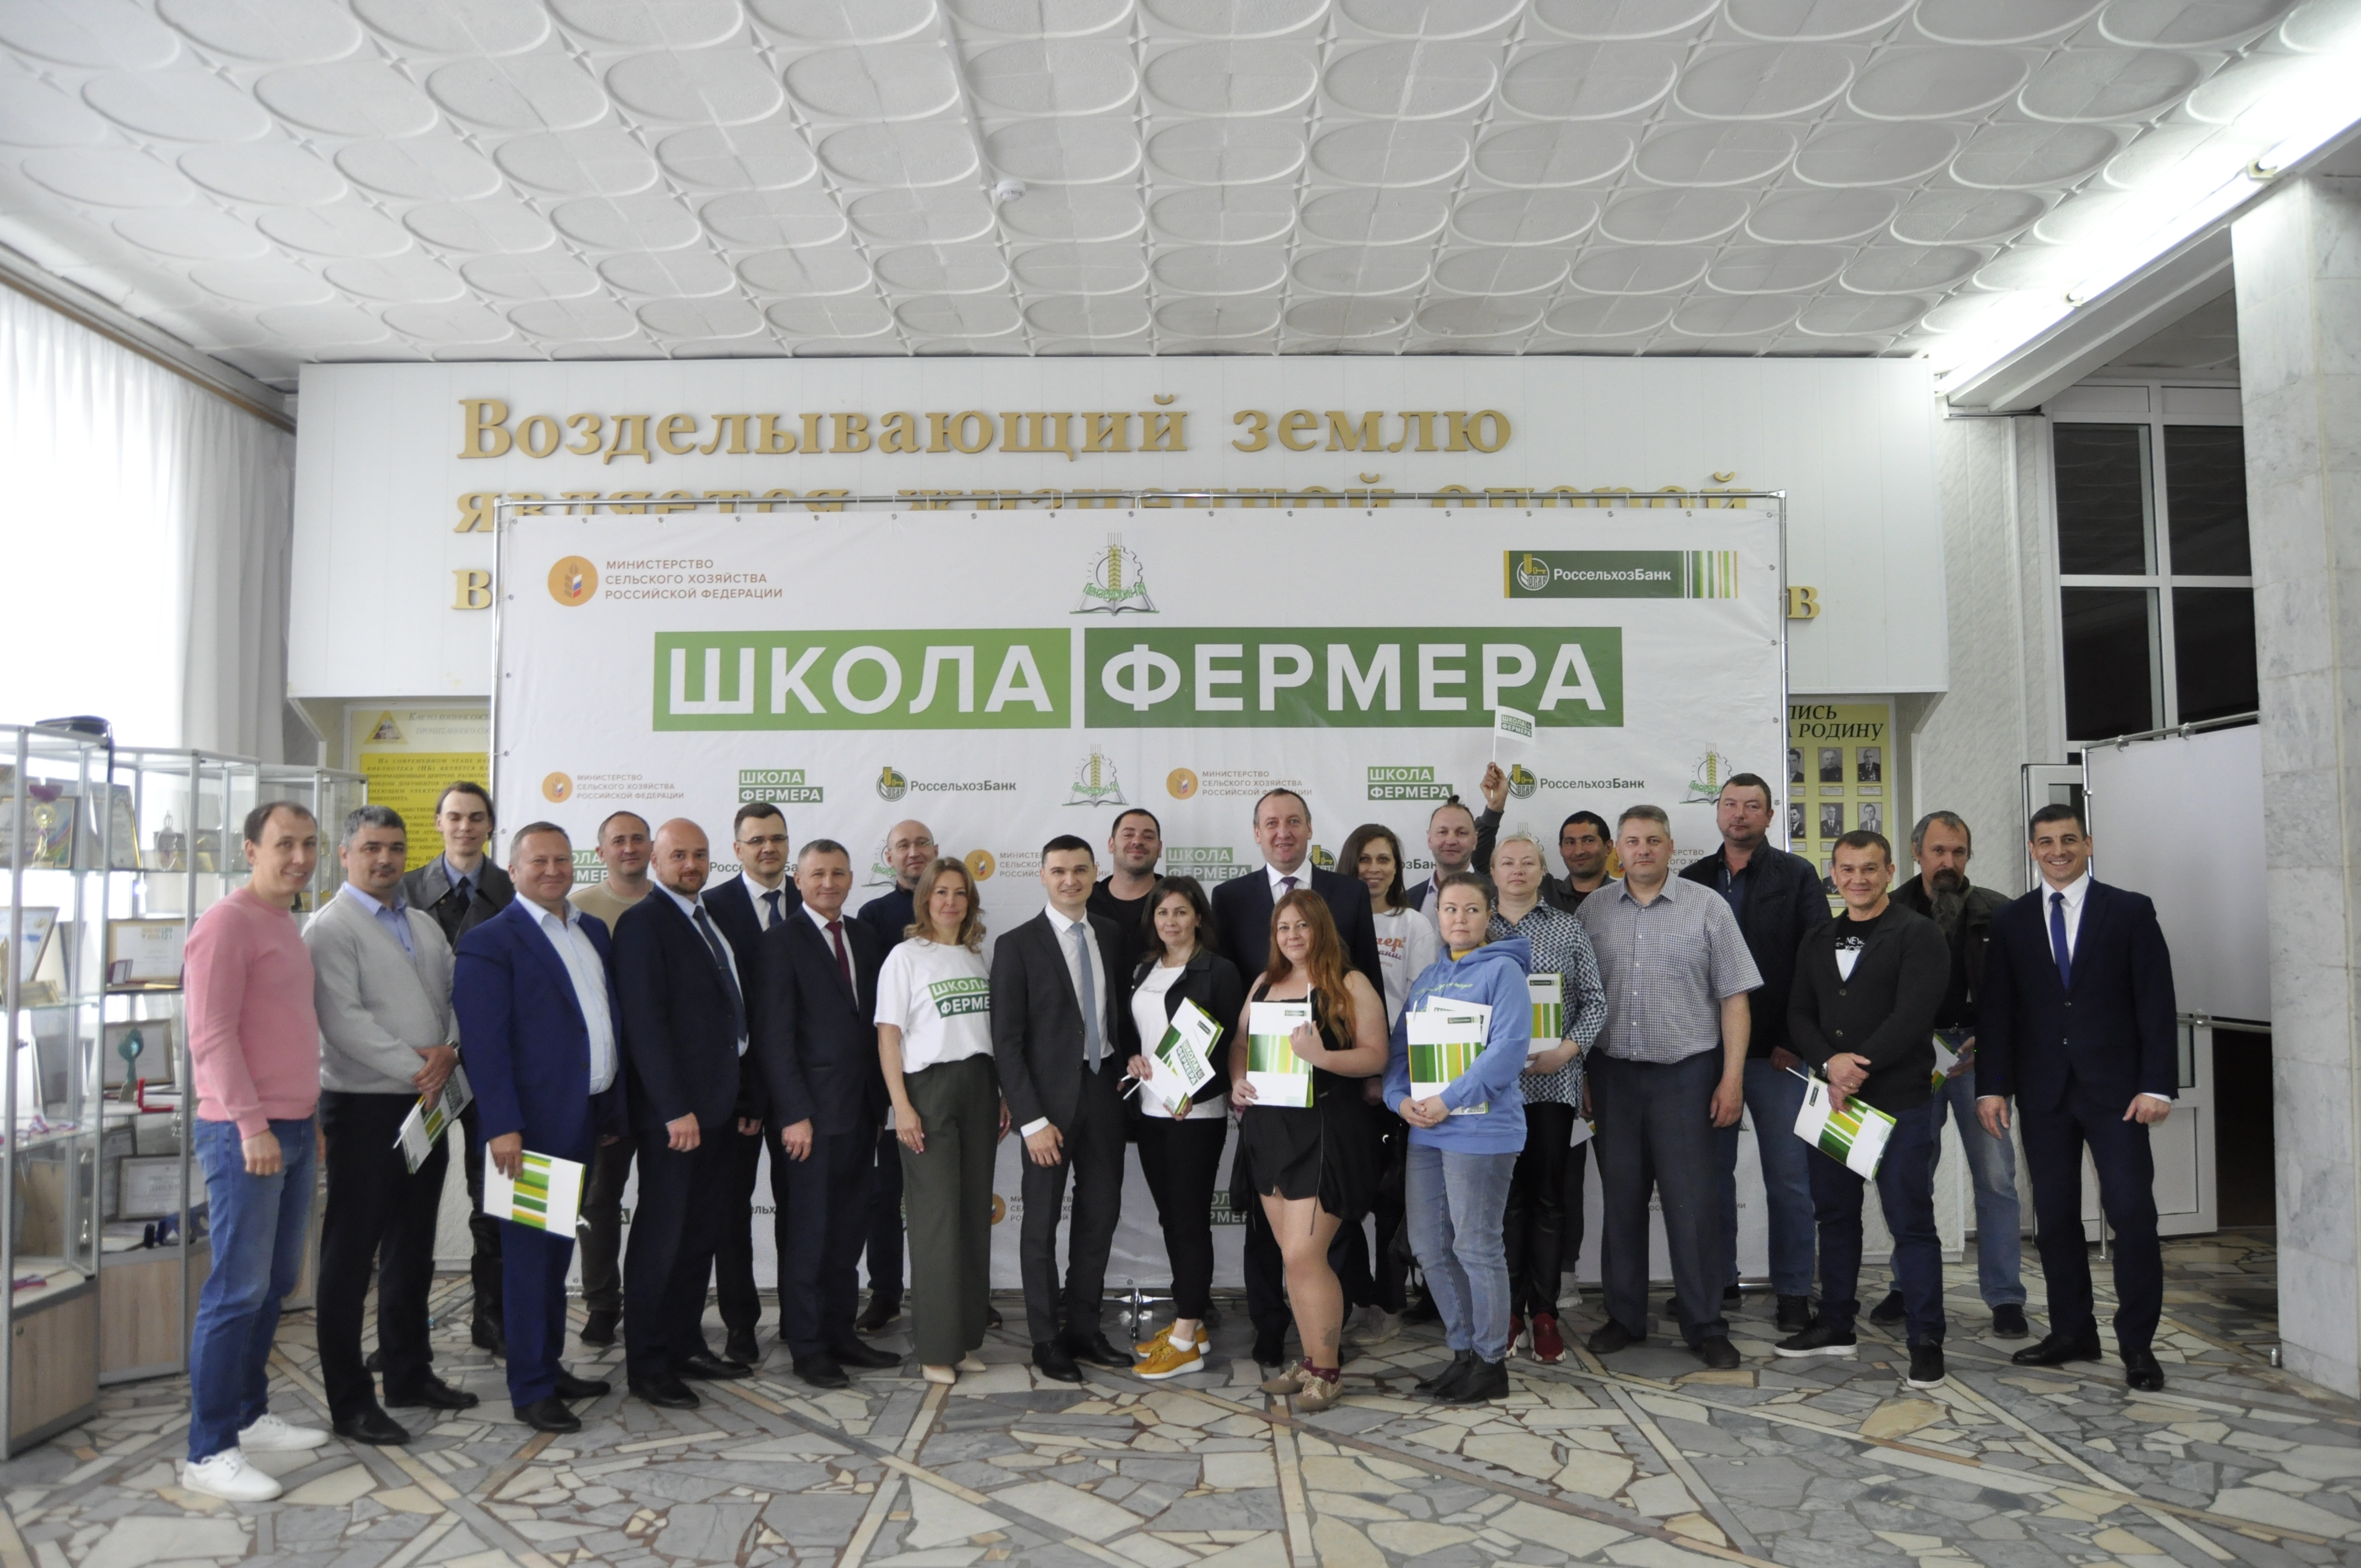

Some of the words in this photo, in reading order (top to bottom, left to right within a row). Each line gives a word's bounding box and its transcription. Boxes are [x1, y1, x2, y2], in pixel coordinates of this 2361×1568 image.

[458, 394, 1187, 464] Возделывающий
[1232, 409, 1511, 453] землю
[606, 559, 714, 570] МИНИСТЕРСТВО
[606, 574, 683, 585] СЕЛЬСКОГО
[688, 573, 767, 584] ХОЗЯЙСТВА
[1553, 568, 1672, 581] РоссельхозБанк
[605, 587, 697, 600] РОССИЙСКОЙ
[701, 588, 783, 599] ФЕДЕРАЦИИ
[669, 645, 1053, 716] ШКОЛА
[1101, 643, 1606, 712] ФЕРМЕРА
[1502, 715, 1525, 727] ШКОЛА
[1502, 723, 1531, 737] ФЕРМЕРА
[1798, 723, 1884, 742] РОДИНУ
[741, 771, 803, 784] ШКОЛА
[1370, 769, 1432, 781] ШКОЛА
[627, 782, 675, 790] ХОЗЯЙСТВА
[910, 780, 1016, 791] РоссельхозБанк
[1253, 778, 1303, 787] ХОЗЯЙСТВА
[1539, 778, 1645, 789] РоссельхозБанк
[741, 789, 821, 801] ФЕРМЕРА
[1370, 786, 1450, 798] ФЕРМЕРА
[1168, 849, 1231, 862] ШКОЛА
[932, 979, 990, 997] ШКОЛА
[940, 996, 991, 1014] ФЕРМЕ
[1183, 1040, 1200, 1071] ШКОЛА
[1177, 1046, 1198, 1086] ФЕРМЕРА
